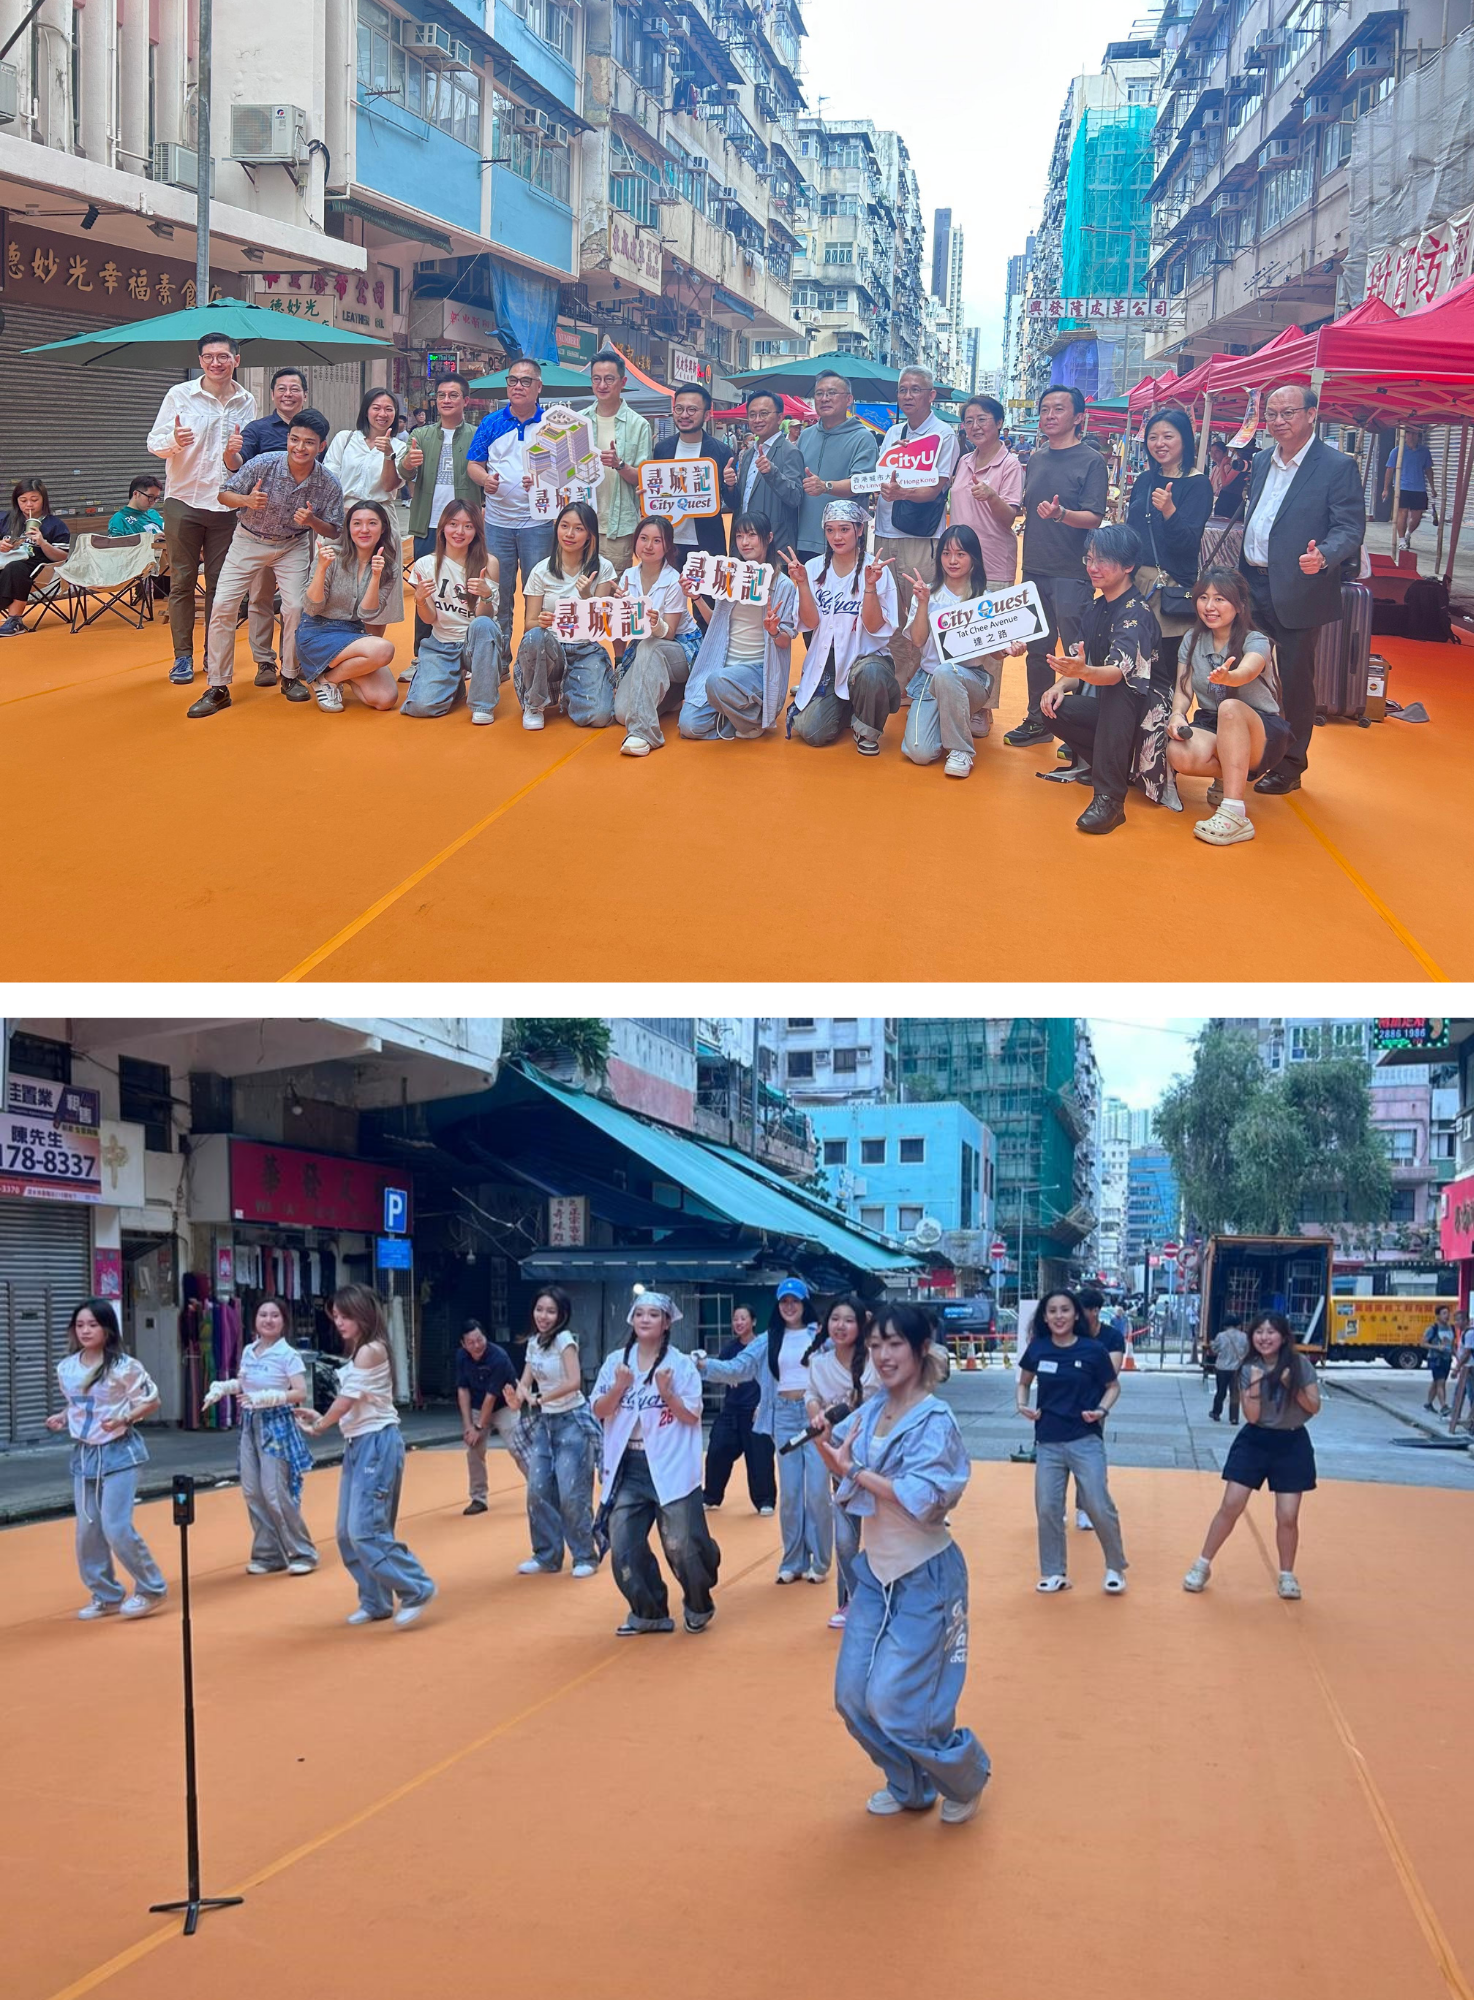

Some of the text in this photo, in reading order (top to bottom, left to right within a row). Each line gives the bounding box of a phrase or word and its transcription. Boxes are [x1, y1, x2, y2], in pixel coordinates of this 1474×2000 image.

[1028, 300, 1168, 317] 興發隆皮革公司
[886, 450, 935, 470] CityU
[646, 465, 712, 496] 尋城記
[649, 497, 712, 513] City Quest
[685, 556, 767, 602] 尋城記
[556, 600, 648, 639] 尋城記
[937, 588, 1030, 629] City Quest
[957, 615, 1019, 639] Tat Chee Avenue
[11, 1125, 63, 1149] 陳先生
[388, 1193, 403, 1227] P
